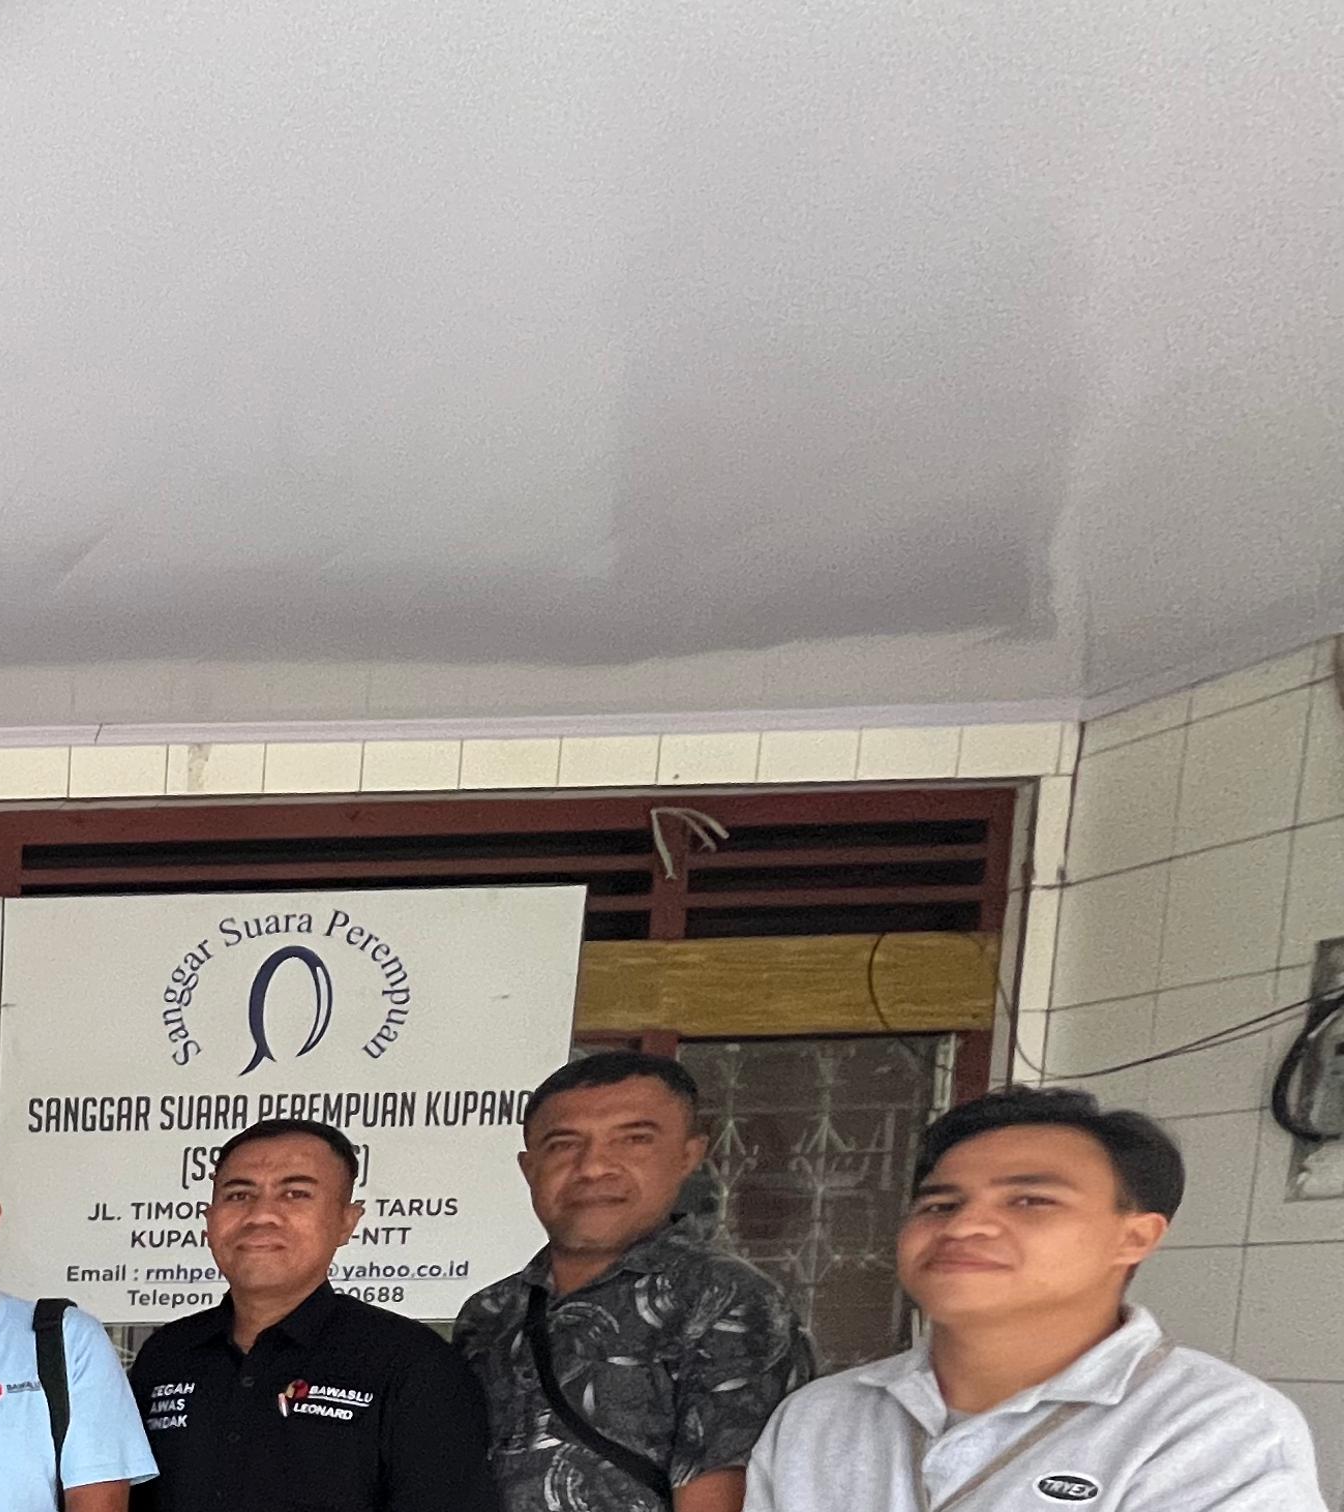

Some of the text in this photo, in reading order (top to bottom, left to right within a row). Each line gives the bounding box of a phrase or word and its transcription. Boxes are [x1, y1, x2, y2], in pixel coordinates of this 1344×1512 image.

[162, 909, 411, 1066] Sanggar Suara Perempuan
[28, 1096, 151, 1133] SANGGAR
[159, 1094, 248, 1130] SUARA
[258, 1091, 416, 1128] PEREMPUAN
[87, 1203, 122, 1221] JL.
[375, 1198, 458, 1217] TARUS
[66, 1264, 126, 1282] Email
[127, 1289, 213, 1308] Telepon
[308, 1385, 374, 1404] BAWASLU
[293, 1403, 354, 1421] LEONARD
